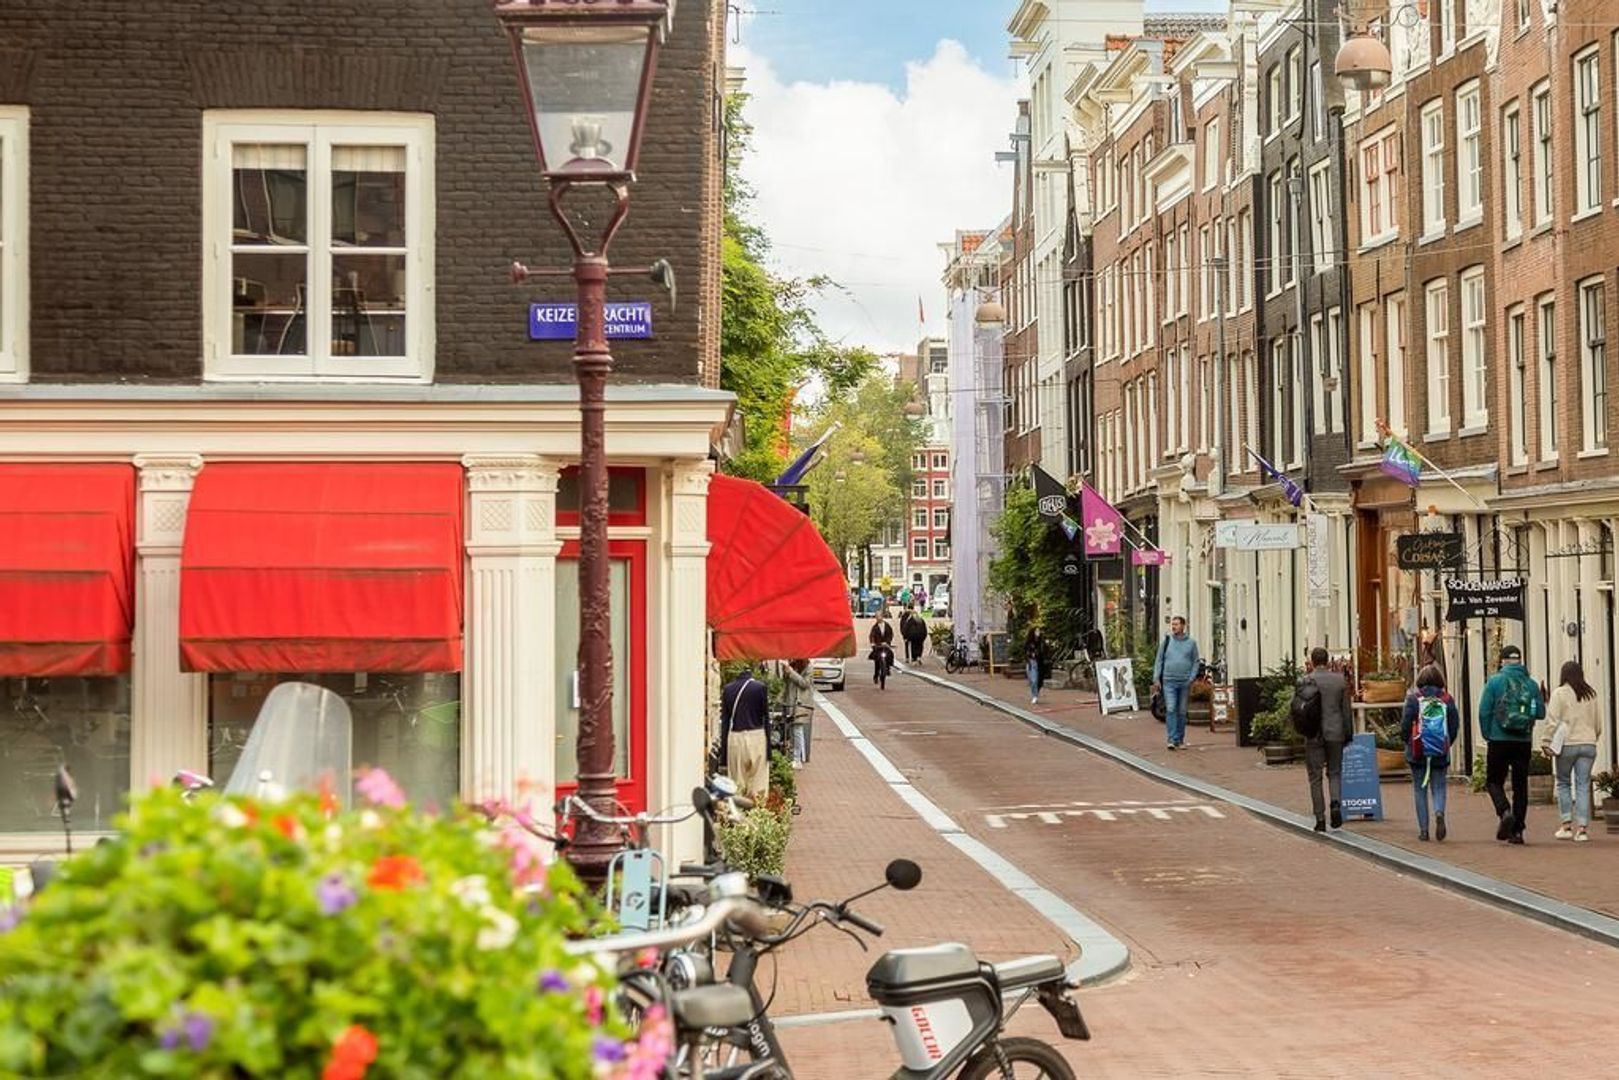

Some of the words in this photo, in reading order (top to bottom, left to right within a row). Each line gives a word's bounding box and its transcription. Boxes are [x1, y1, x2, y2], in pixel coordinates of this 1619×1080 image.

[537, 308, 645, 322] KEIZERACHT
[604, 324, 645, 334] CENTRUM
[1448, 577, 1521, 591] SCHOENMAKERIJ
[1342, 798, 1377, 807] STOOKER
